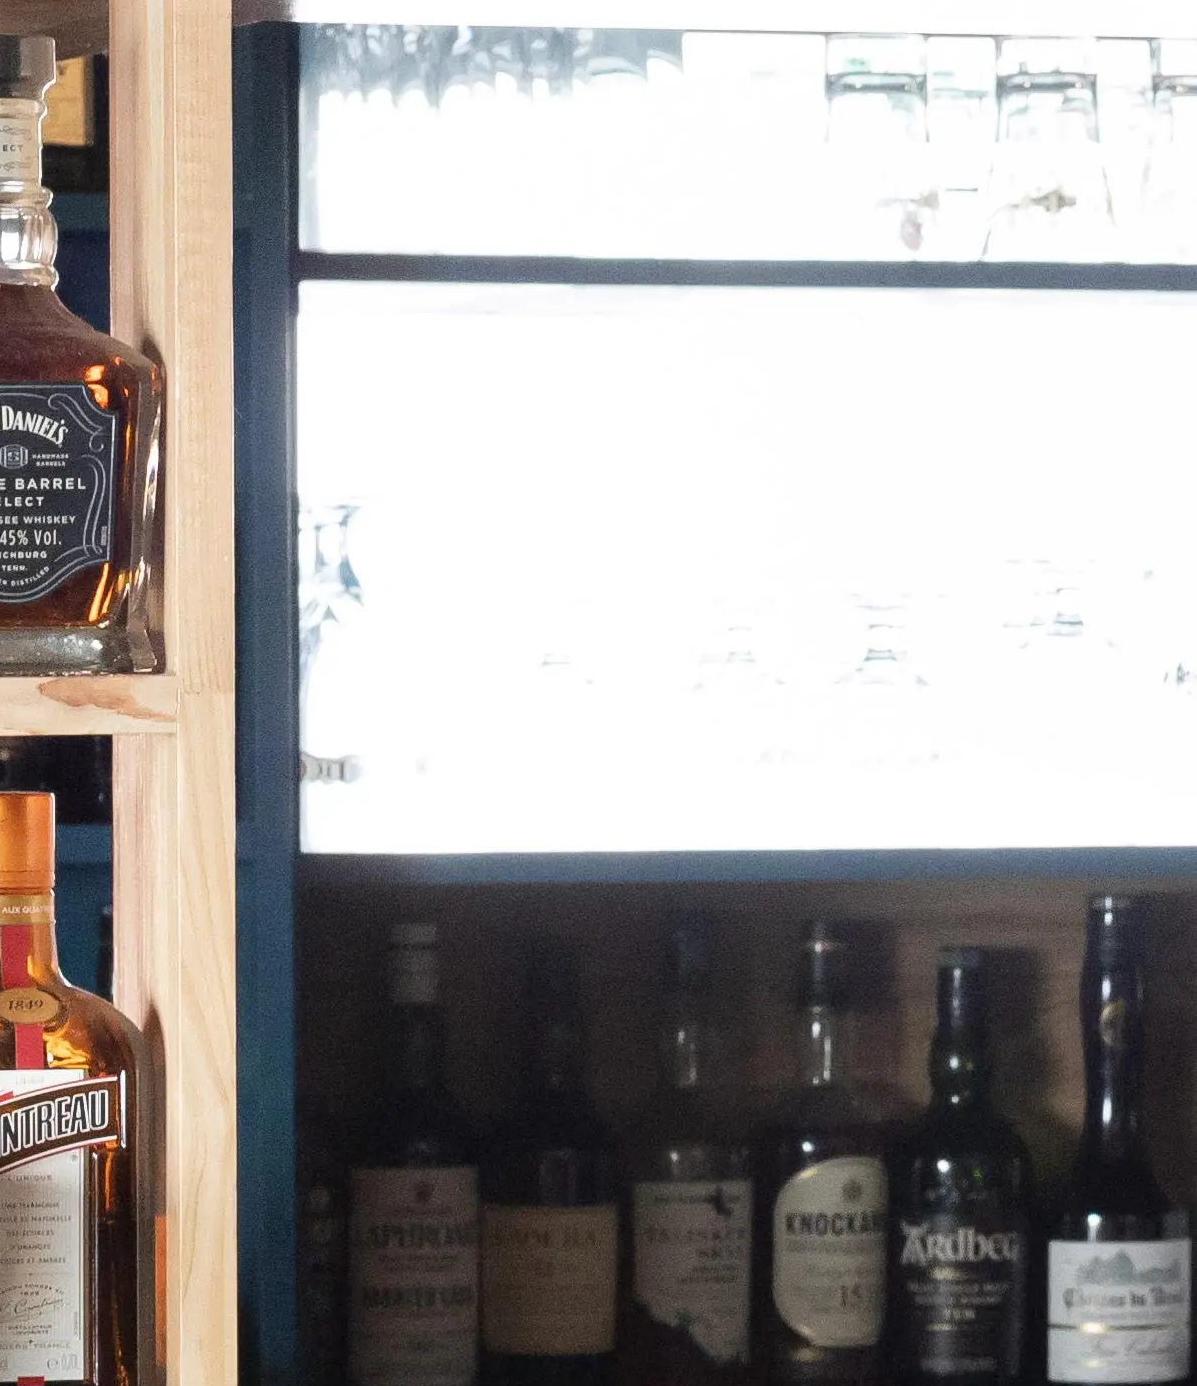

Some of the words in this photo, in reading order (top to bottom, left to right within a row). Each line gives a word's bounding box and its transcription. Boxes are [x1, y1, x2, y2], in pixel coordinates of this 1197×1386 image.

[14, 477, 86, 490] BARREL
[23, 515, 77, 525] WHISKEY
[0, 529, 29, 546] 45%
[33, 529, 62, 546] Vol.
[7, 999, 44, 1011] 1849
[785, 1211, 881, 1236] KNOCKA
